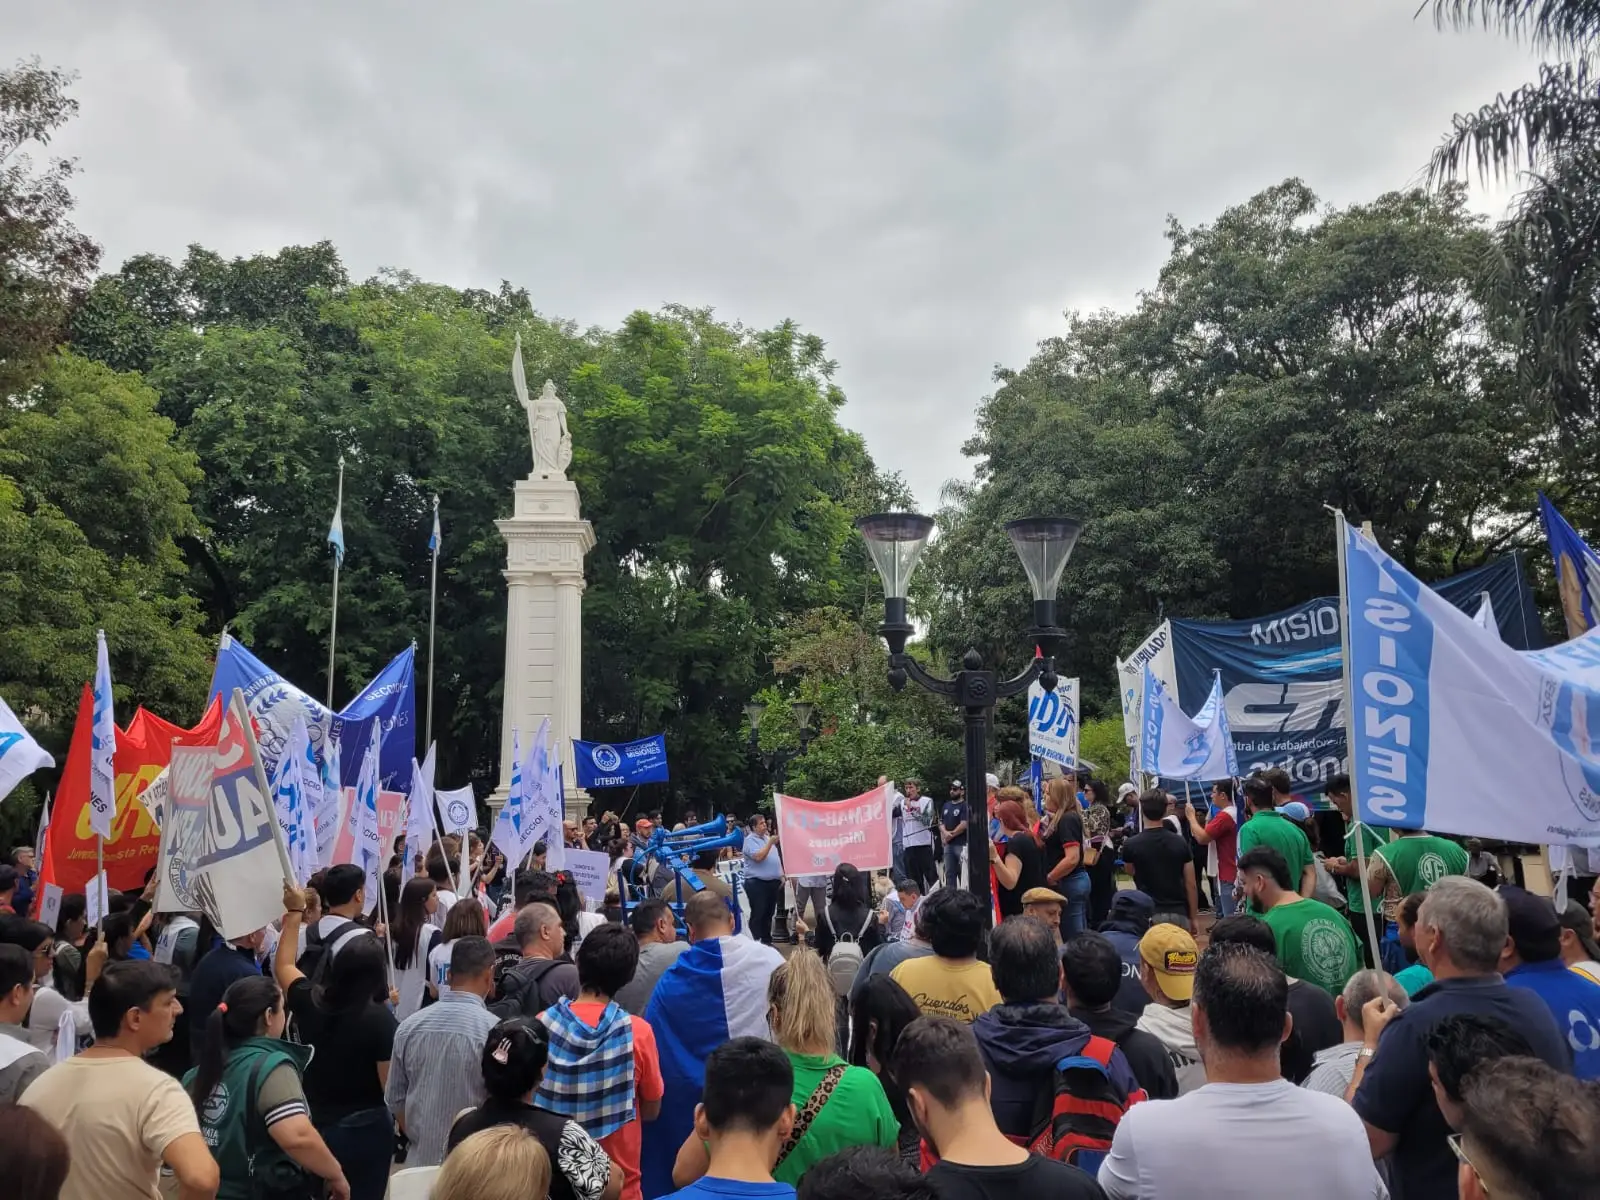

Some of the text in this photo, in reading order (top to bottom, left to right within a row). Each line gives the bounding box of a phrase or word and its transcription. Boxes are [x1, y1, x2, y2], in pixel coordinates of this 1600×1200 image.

[1251, 606, 1339, 645] MISIO
[1231, 740, 1254, 752] ntral
[1257, 741, 1271, 752] de
[626, 747, 661, 758] MISIONES
[594, 776, 625, 786] UTEDYC
